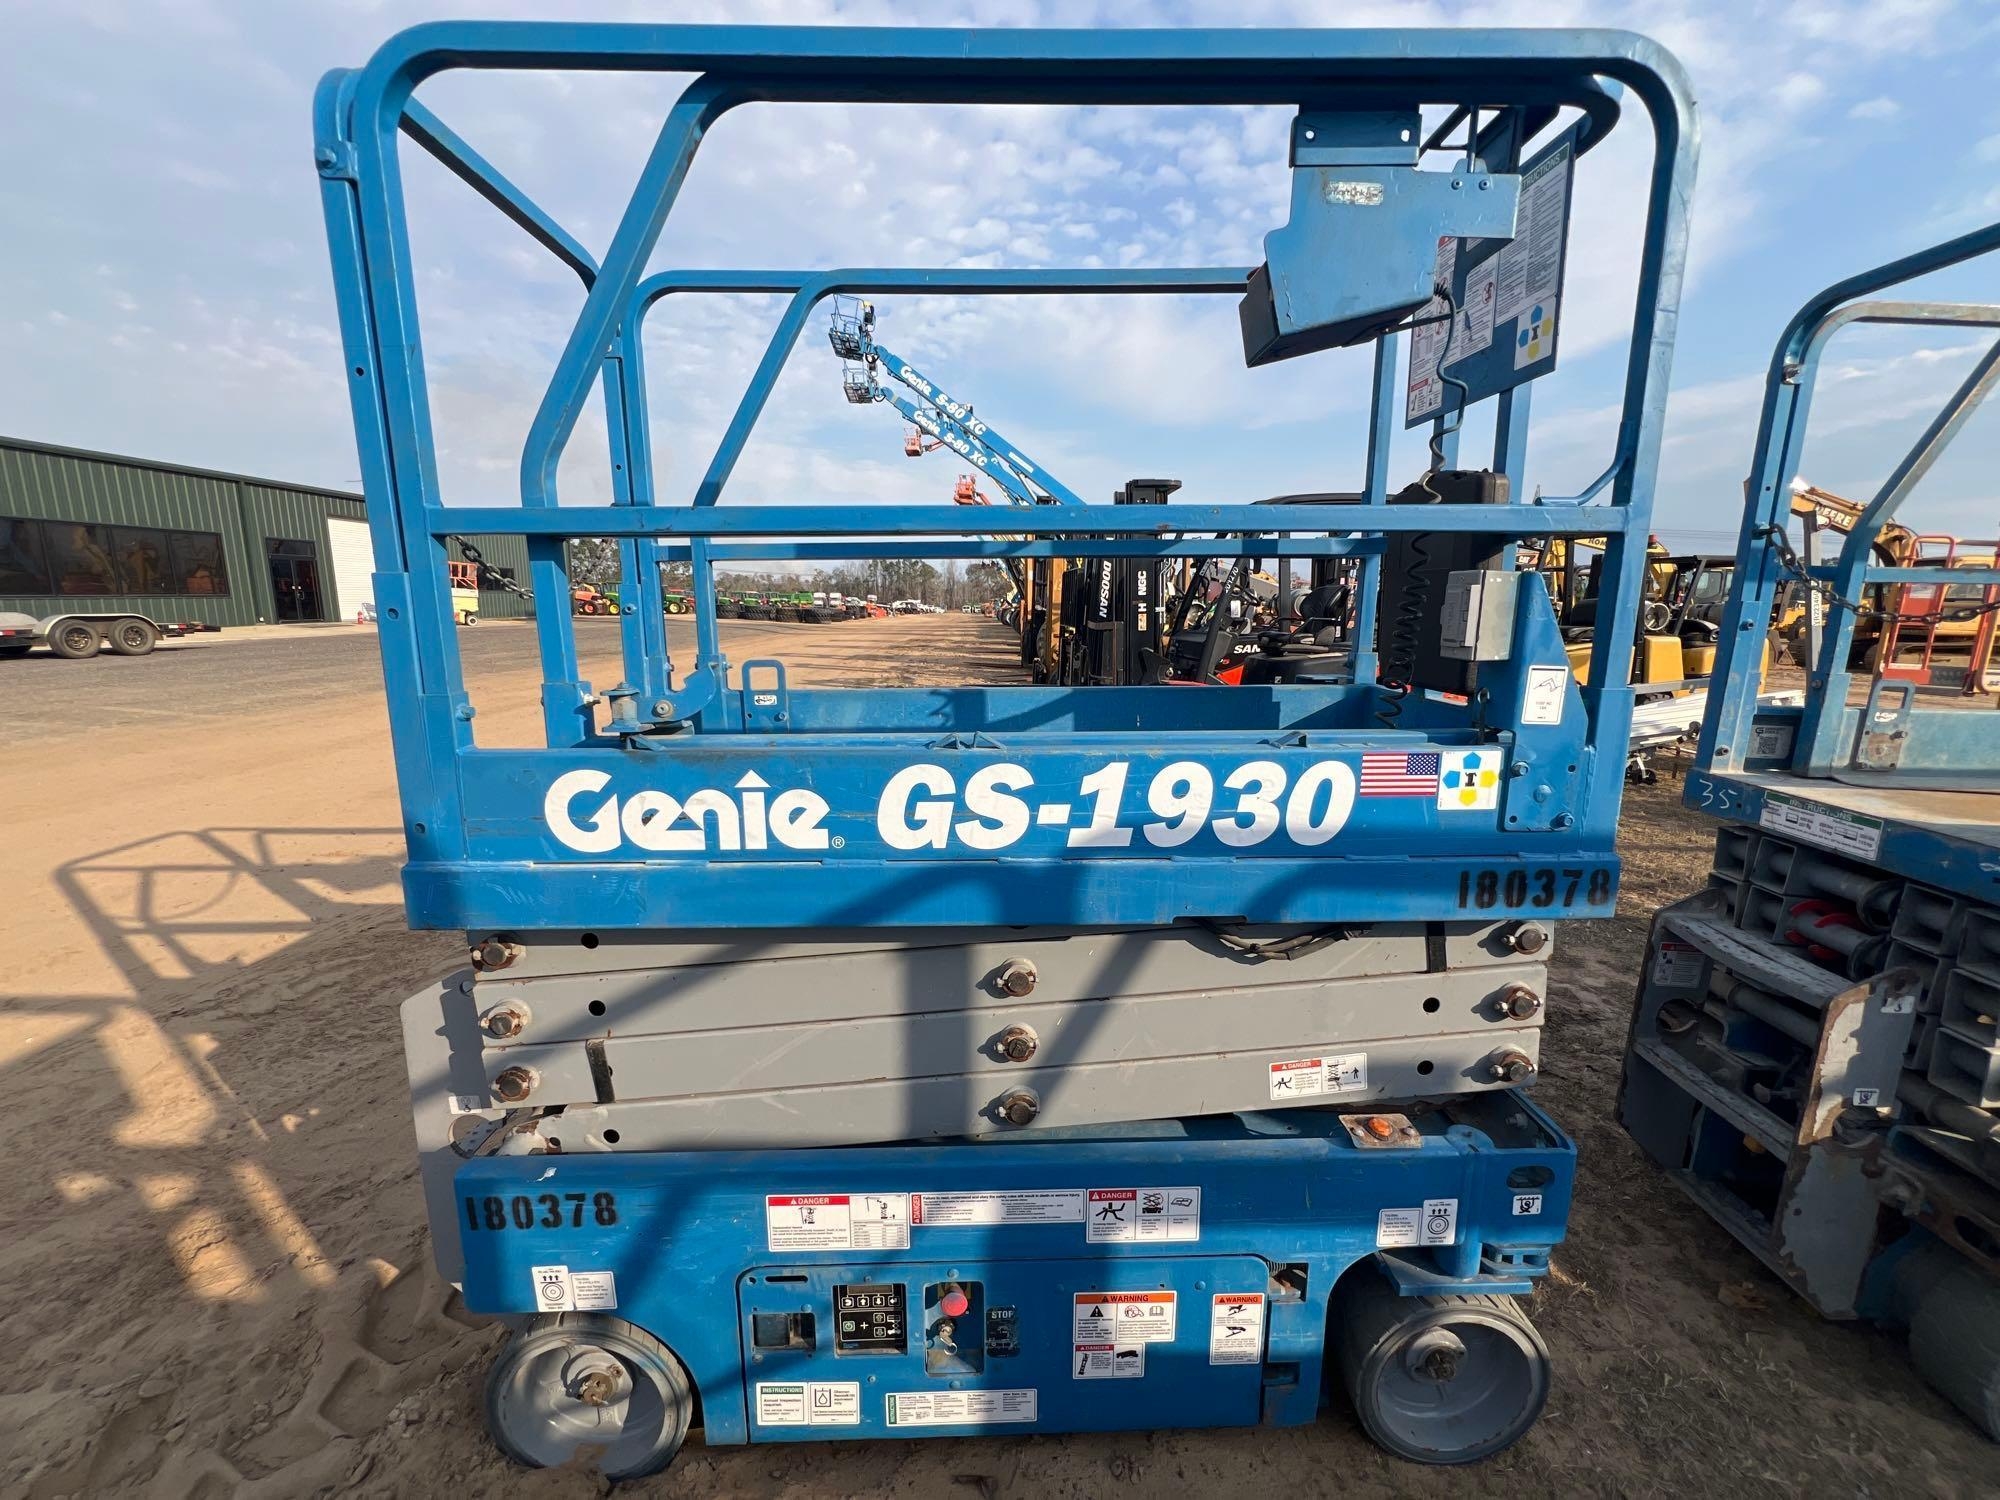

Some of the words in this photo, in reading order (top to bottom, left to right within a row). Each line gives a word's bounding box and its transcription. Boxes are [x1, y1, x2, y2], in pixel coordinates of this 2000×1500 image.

[901, 366, 932, 396] Genie
[965, 416, 987, 435] XC
[913, 411, 941, 435] Genie
[969, 450, 988, 467] XC
[1099, 560, 1112, 618] DOOSAN
[544, 768, 831, 853] Genie
[877, 759, 1357, 850] GS-1930
[1698, 778, 1739, 808] 35
[1457, 868, 1612, 910] 180378
[465, 1191, 618, 1231] 180378
[798, 1197, 830, 1205] DANGER
[913, 1195, 921, 1219] DANGER
[991, 1310, 1014, 1319] STOP
[1110, 1294, 1149, 1302] WARNING
[1225, 1296, 1259, 1304] WARNING
